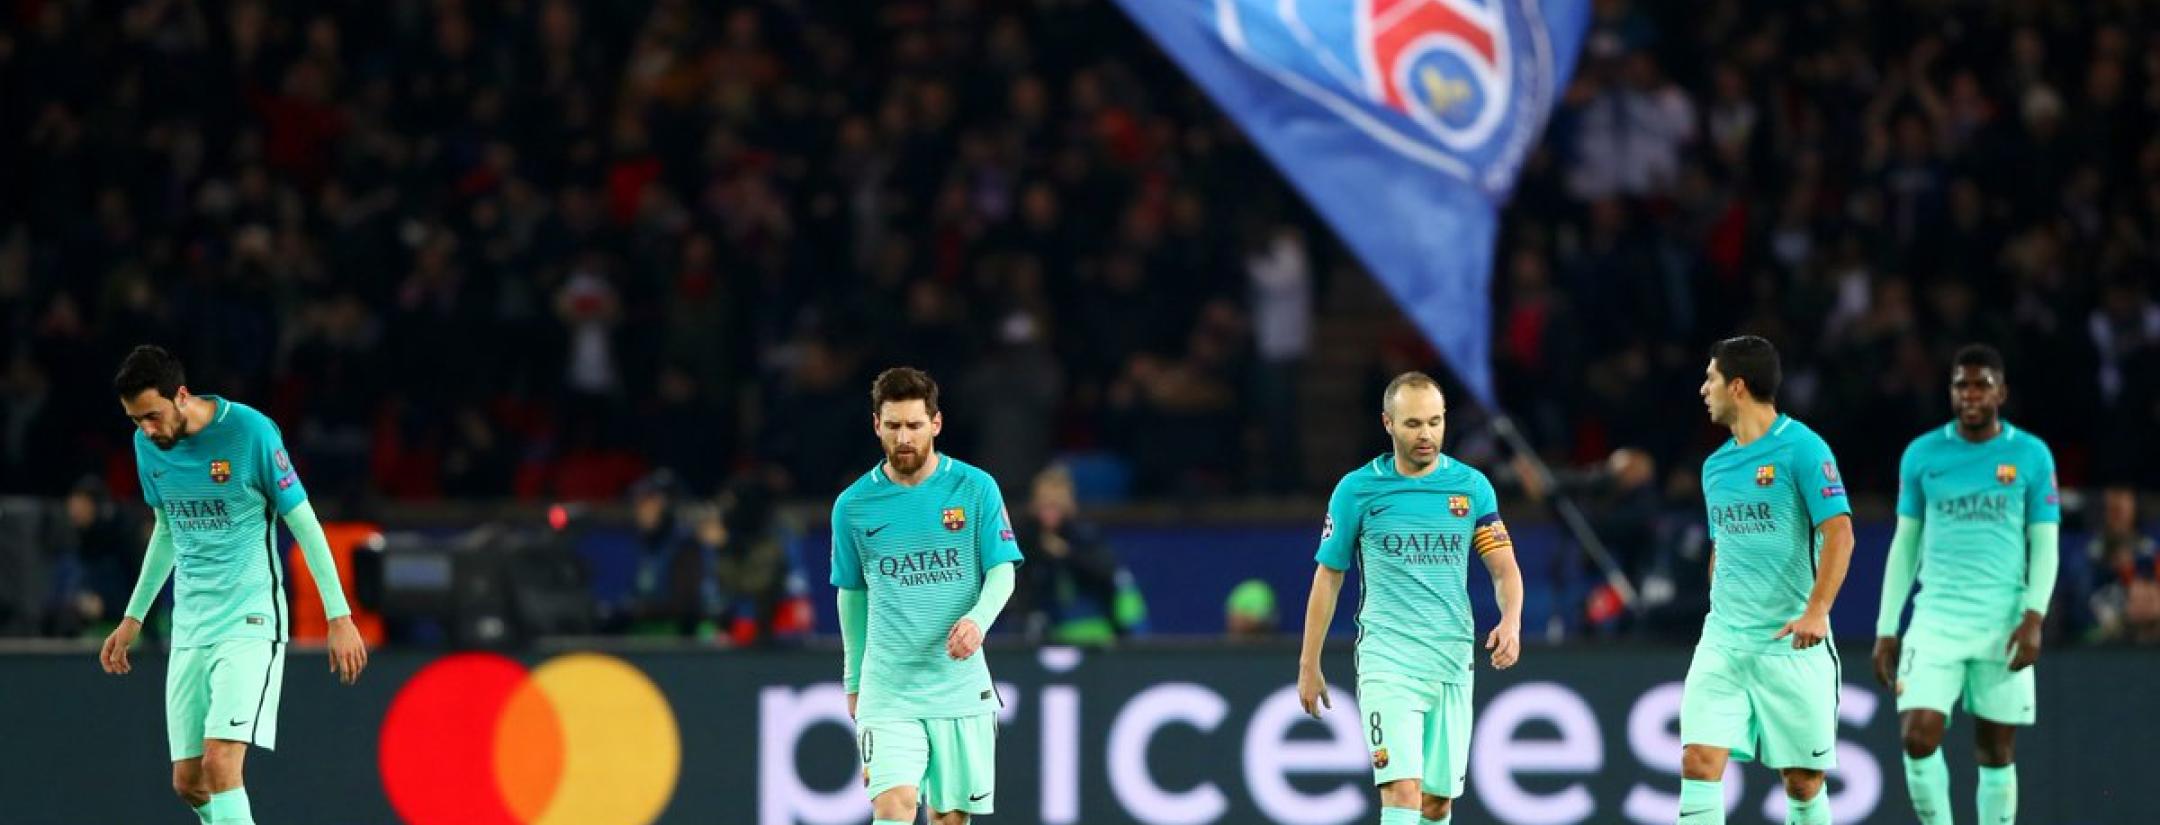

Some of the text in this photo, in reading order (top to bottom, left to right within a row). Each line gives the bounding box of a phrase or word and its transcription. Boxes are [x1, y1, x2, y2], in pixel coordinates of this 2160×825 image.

[1710, 501, 1772, 527] QATAR
[1383, 532, 1462, 557] QATAR
[879, 547, 960, 578] QATAR
[901, 568, 962, 587] AIRWAYS
[757, 644, 1883, 825] piceess
[1370, 711, 1383, 746] 8
[857, 728, 874, 764] 0
